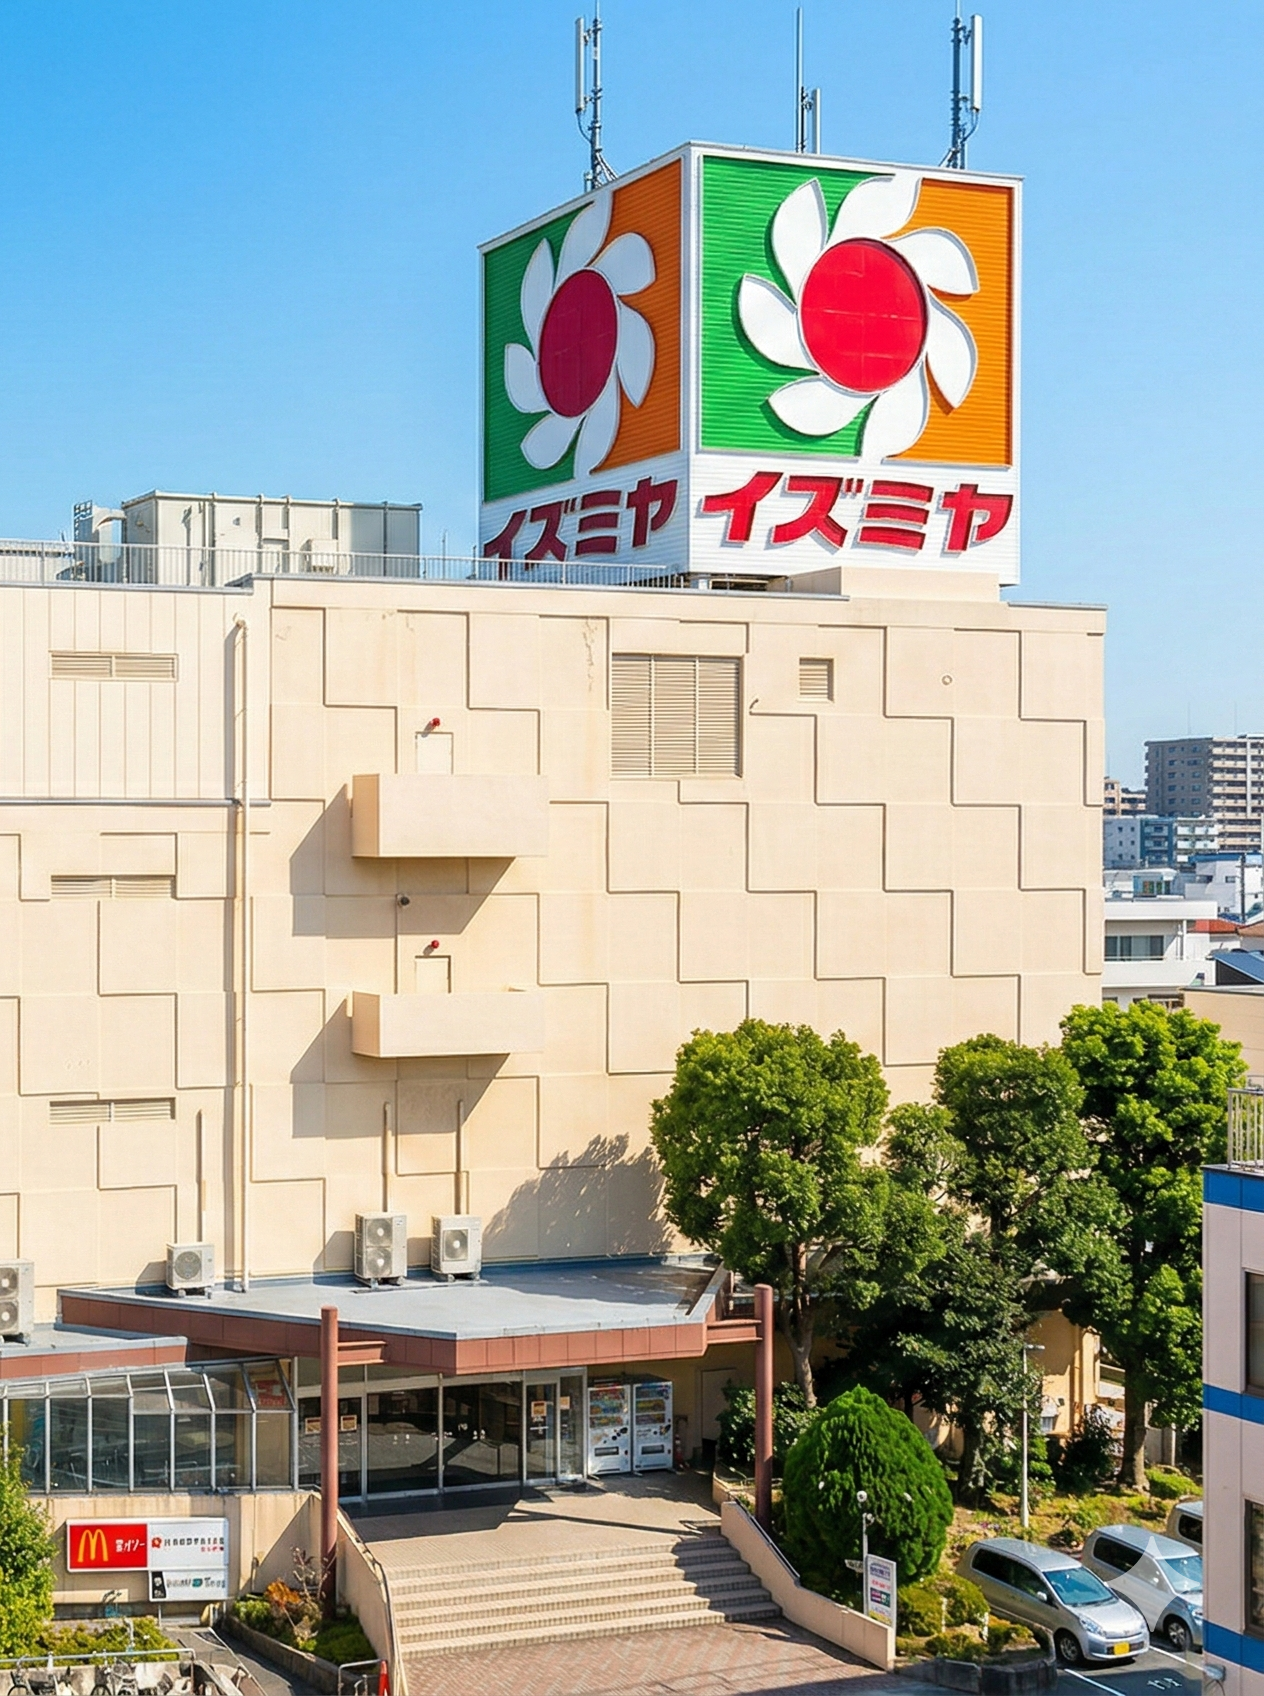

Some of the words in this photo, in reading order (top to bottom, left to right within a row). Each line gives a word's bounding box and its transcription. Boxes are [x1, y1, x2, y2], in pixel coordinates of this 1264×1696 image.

[483, 476, 678, 580] イズミヤ
[702, 471, 1014, 550] イズミヤ
